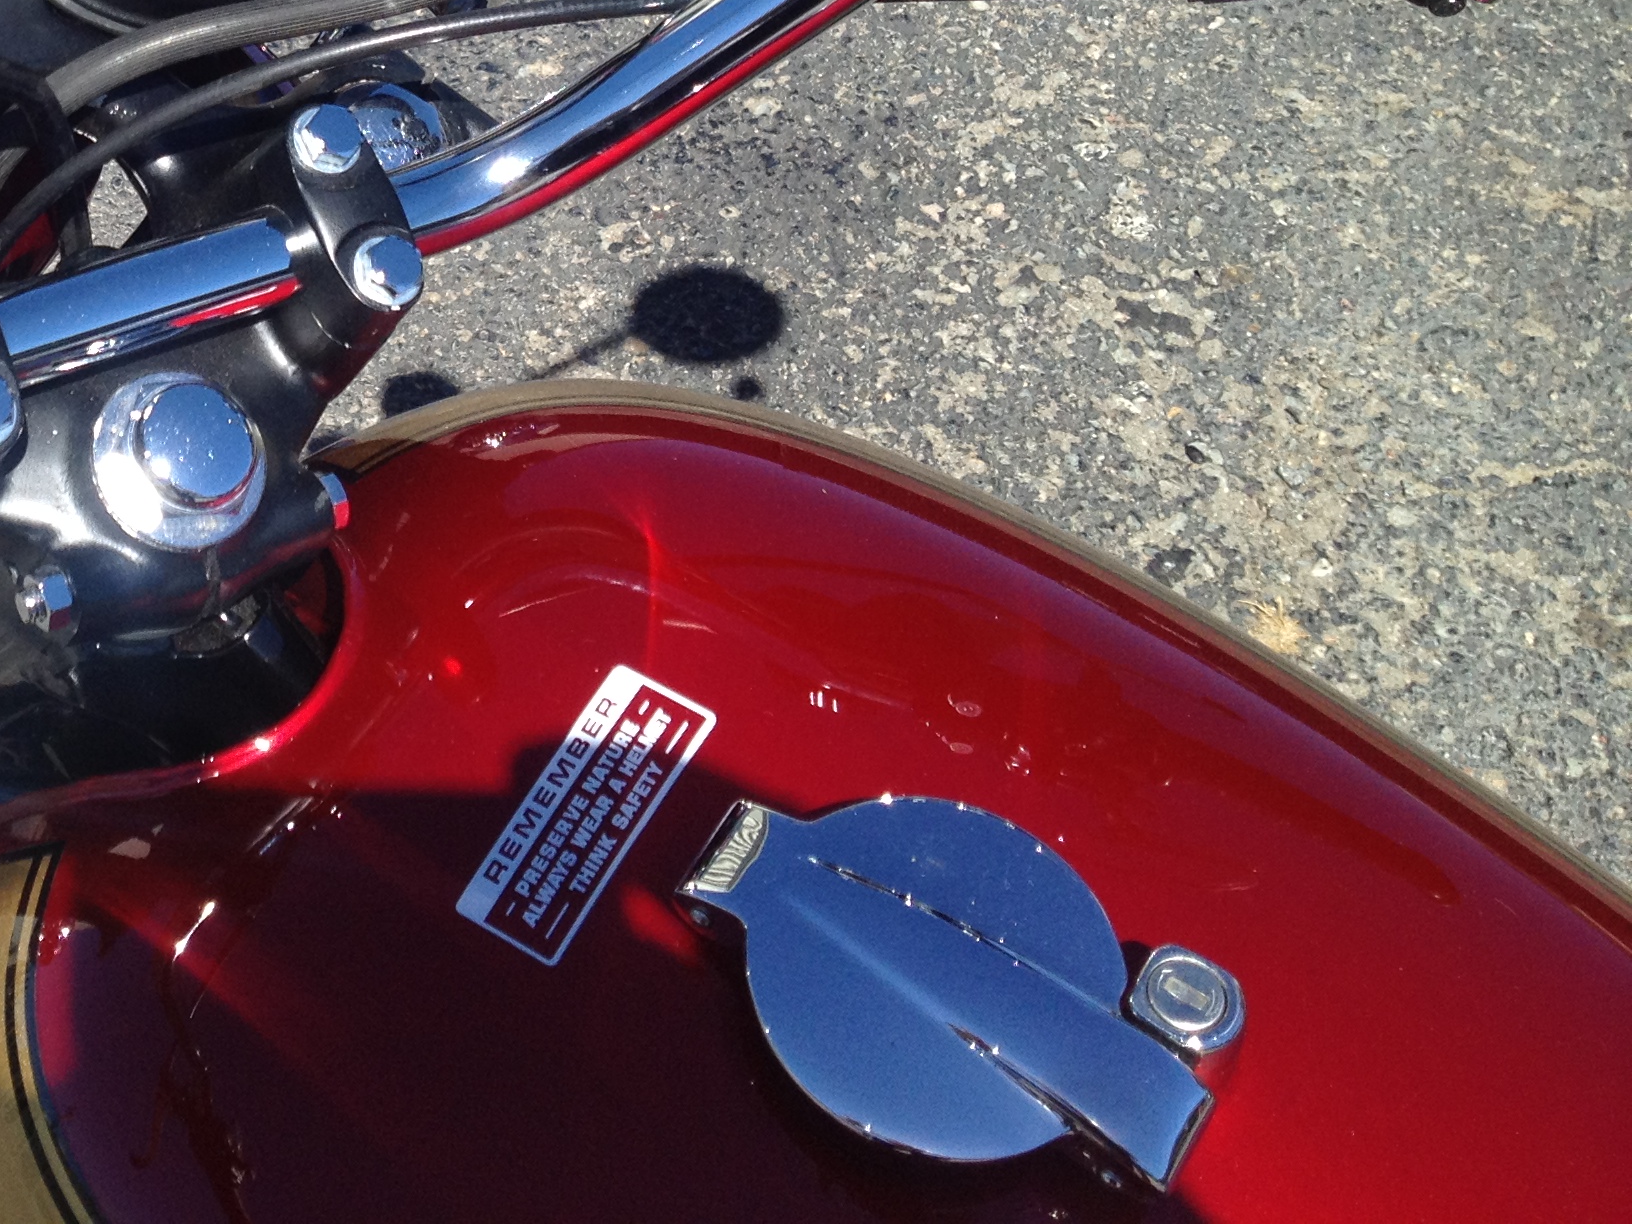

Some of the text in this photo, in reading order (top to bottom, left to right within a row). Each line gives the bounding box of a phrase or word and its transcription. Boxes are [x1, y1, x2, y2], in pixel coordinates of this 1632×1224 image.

[484, 697, 618, 885] REMEMBER
[515, 719, 641, 897] PRESERVE NATURE
[522, 849, 577, 928] ALWAYS
[570, 794, 615, 849] WEAR
[607, 776, 627, 794] A
[569, 760, 664, 894] THINK SAFETY
